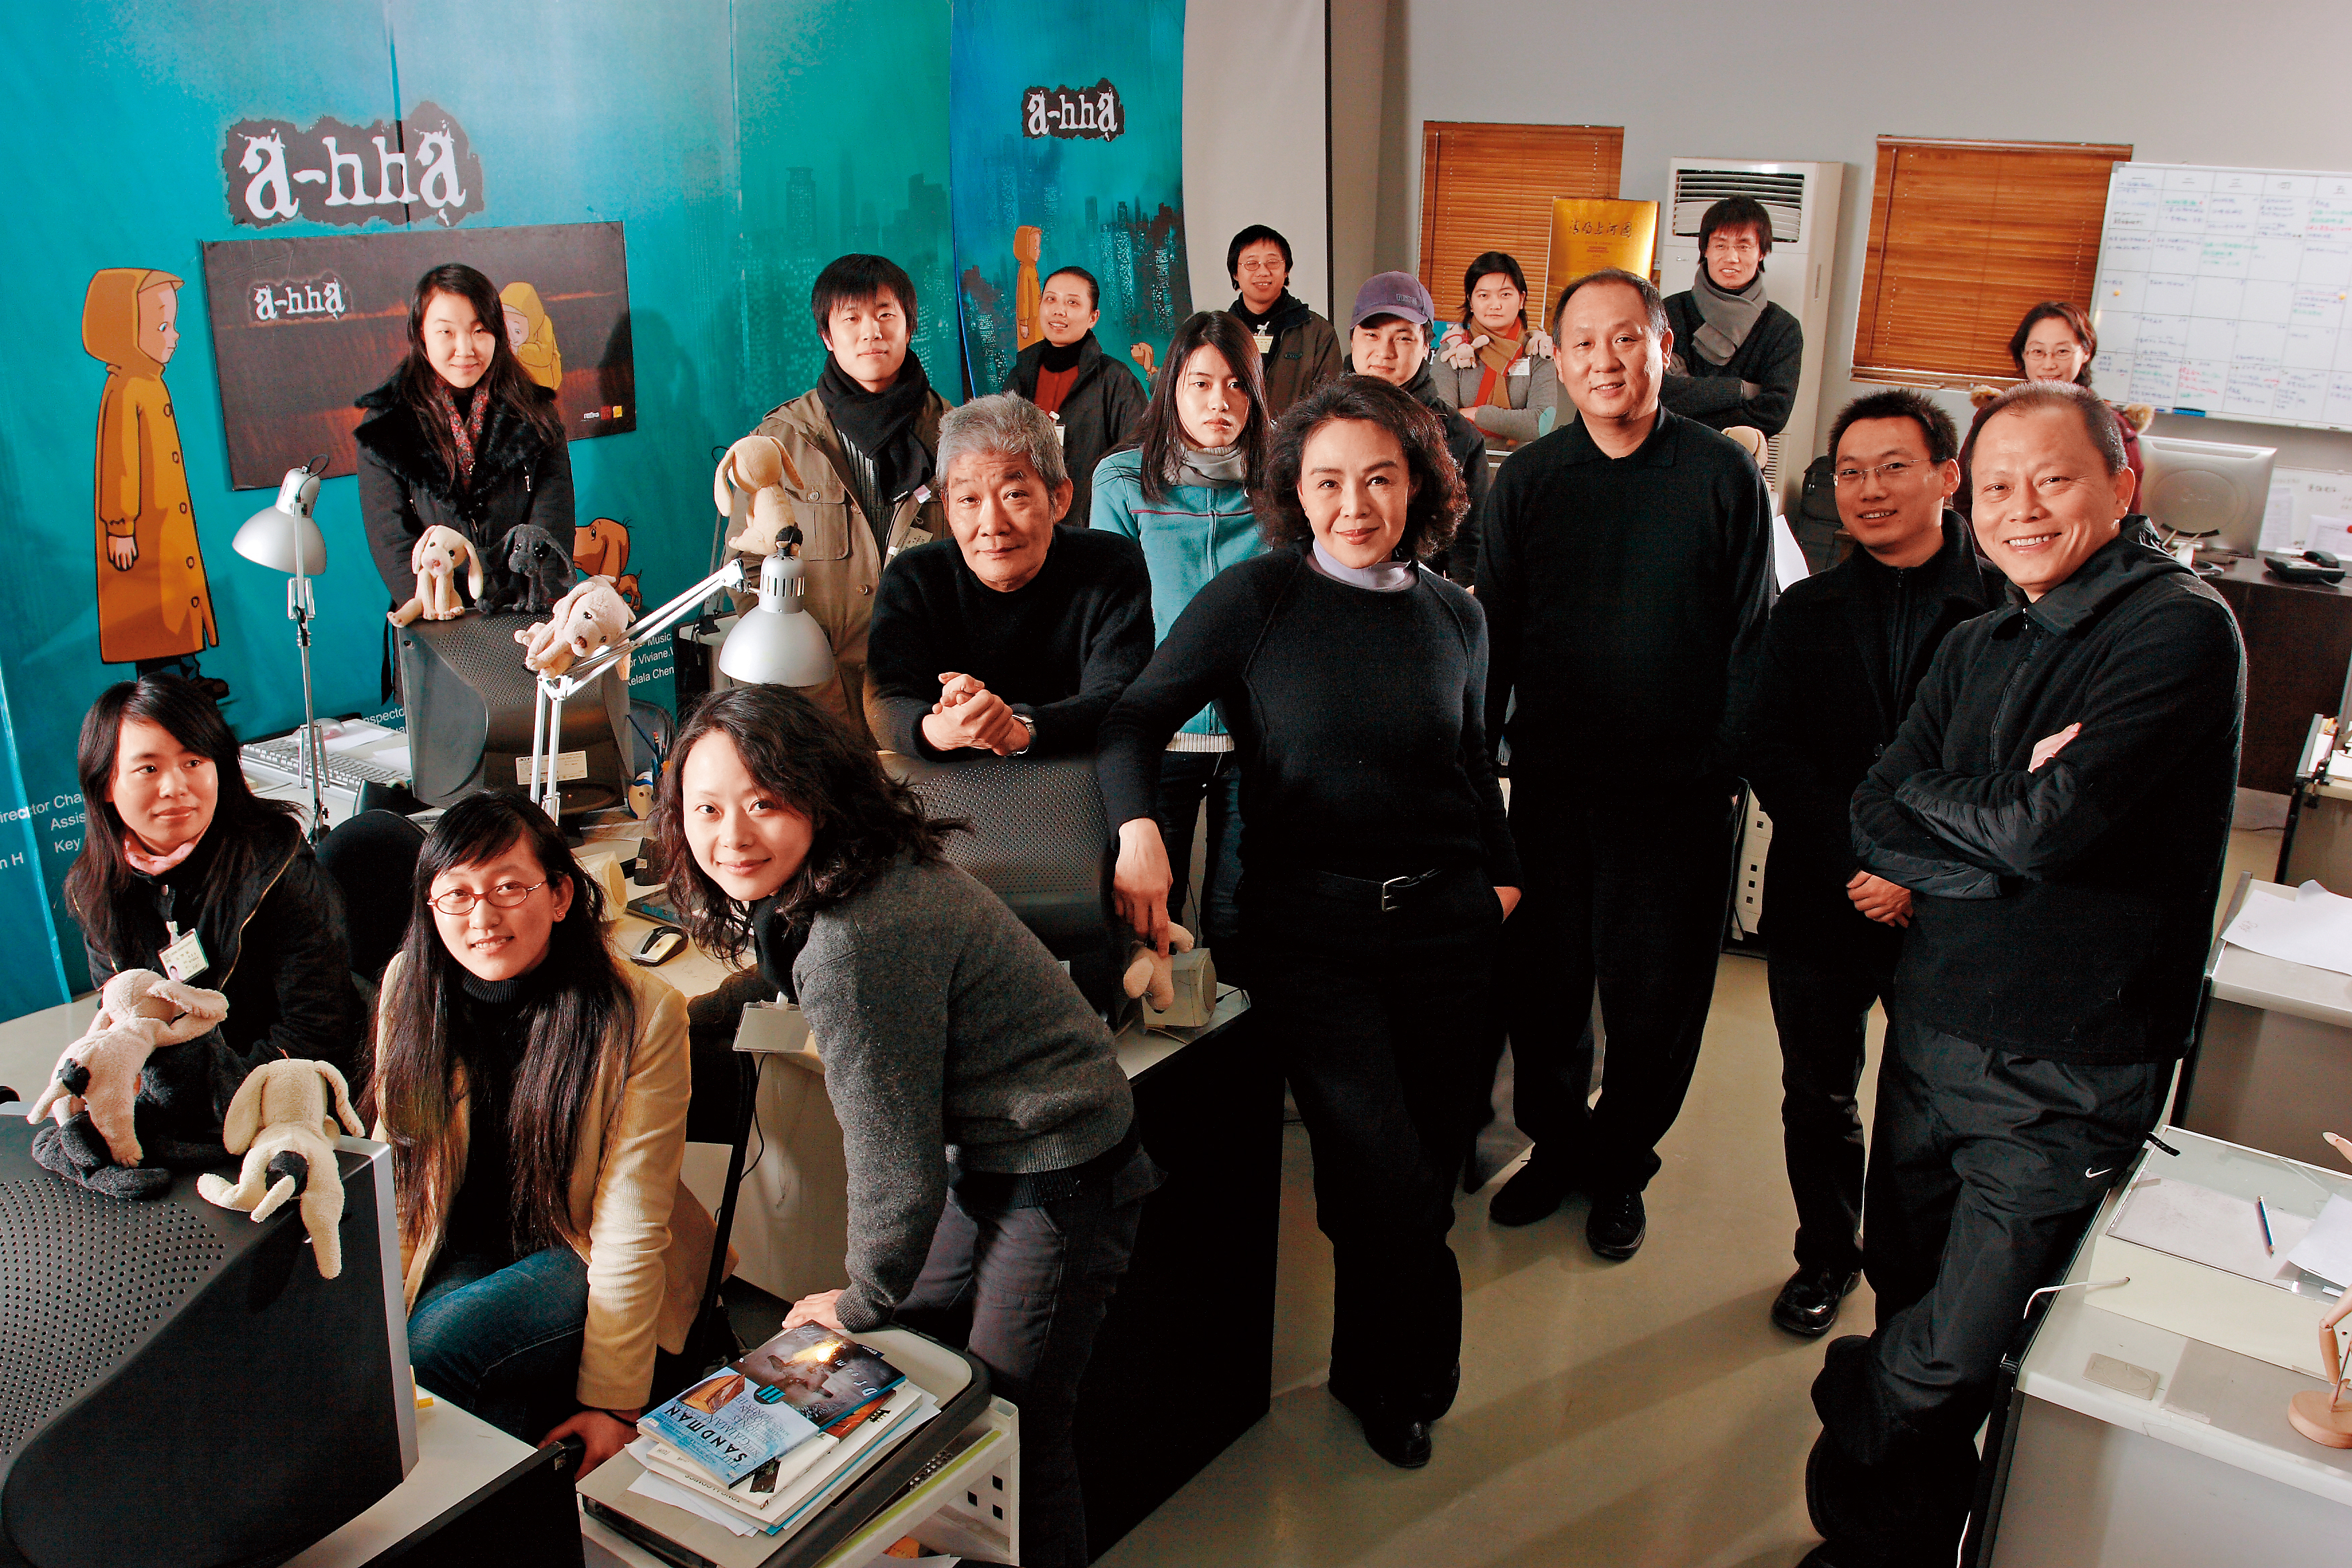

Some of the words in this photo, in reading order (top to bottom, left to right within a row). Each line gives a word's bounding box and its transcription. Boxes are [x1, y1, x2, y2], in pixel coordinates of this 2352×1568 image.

[1026, 87, 1118, 141] a-hha
[238, 125, 466, 226] a-hha
[254, 277, 346, 320] a-hha
[647, 632, 671, 646] Music
[652, 667, 675, 679] Chen
[54, 793, 85, 808] Cha
[51, 812, 85, 831] Assis
[54, 838, 80, 853] Key
[11, 852, 23, 866] H
[664, 1404, 747, 1462] SANDMAN
